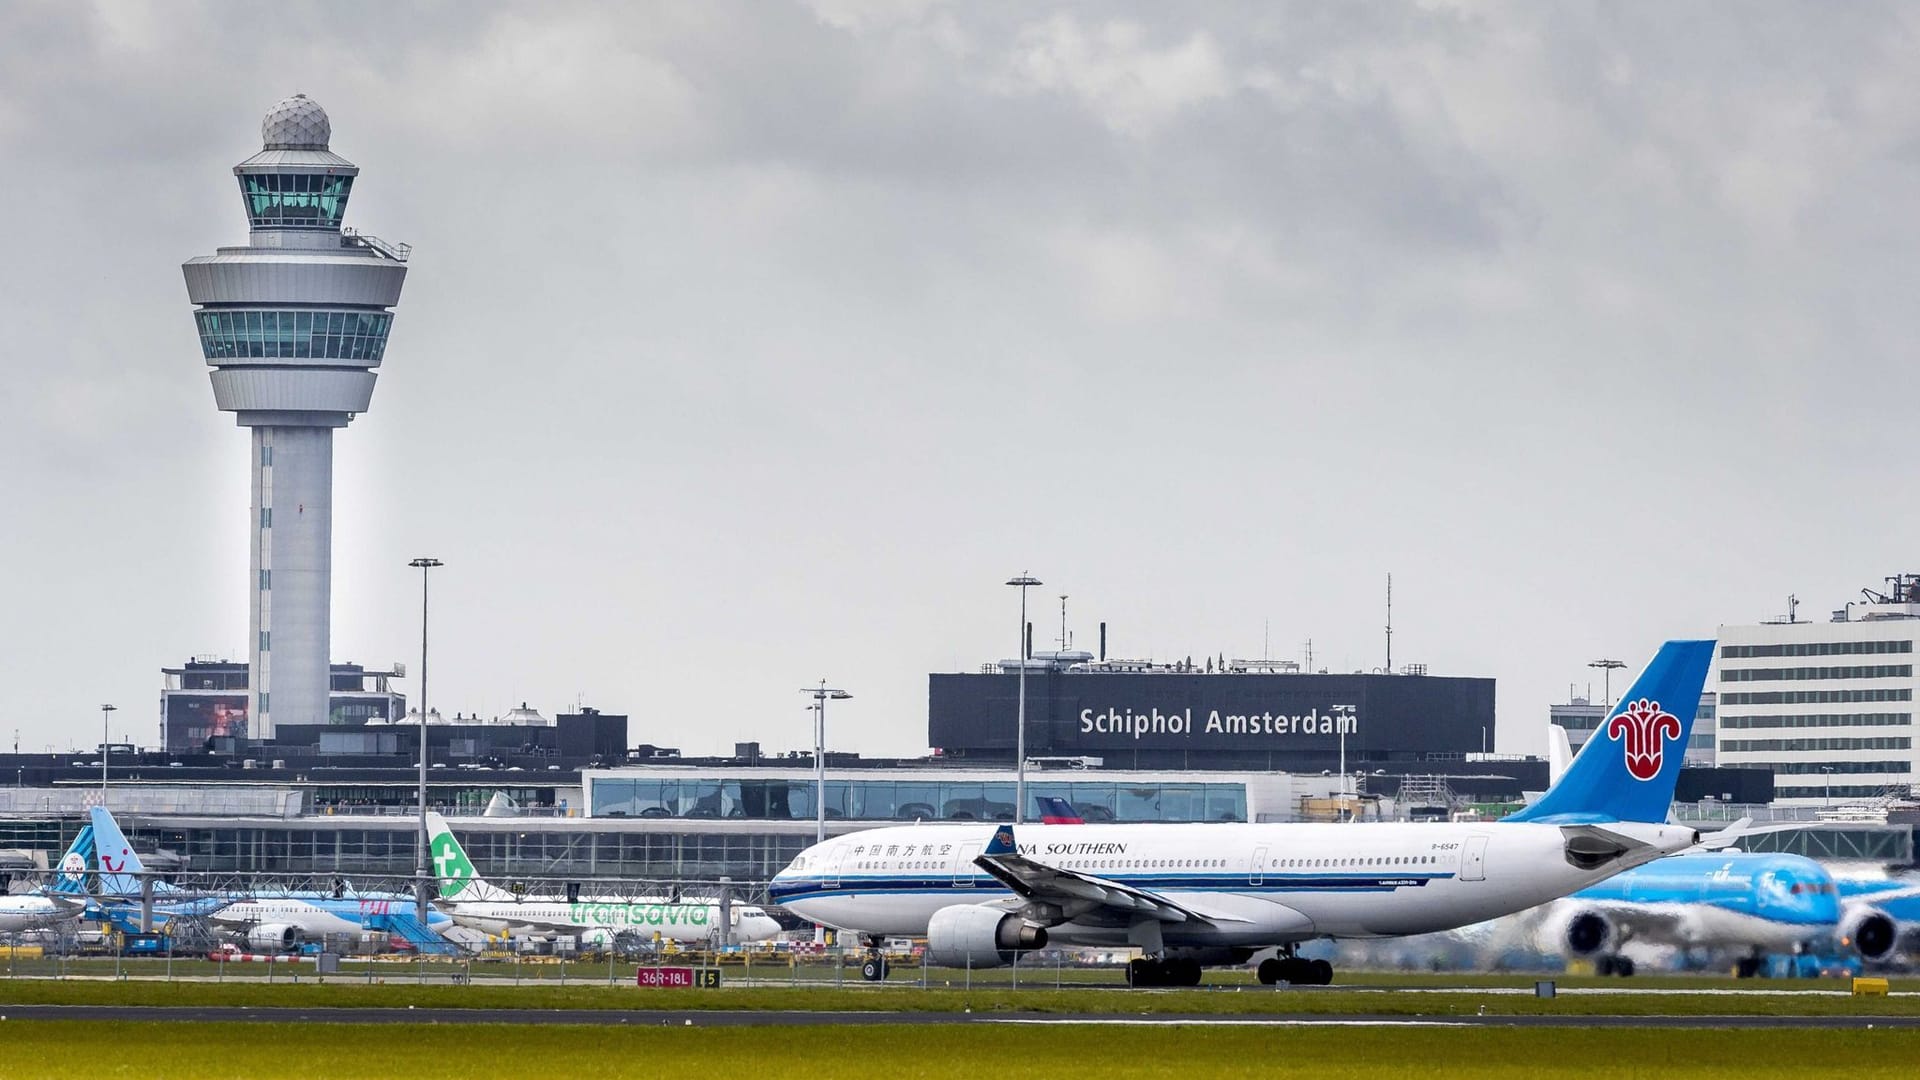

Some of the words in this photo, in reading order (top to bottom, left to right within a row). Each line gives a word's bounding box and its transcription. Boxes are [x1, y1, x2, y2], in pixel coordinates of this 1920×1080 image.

[1080, 708, 1191, 739] Schiphol
[1205, 708, 1357, 734] Amsterdam
[854, 843, 952, 857] 中国南方航空
[1045, 843, 1127, 855] SOUTHERN
[569, 902, 709, 926] transavia
[642, 972, 688, 985] 36R-18L
